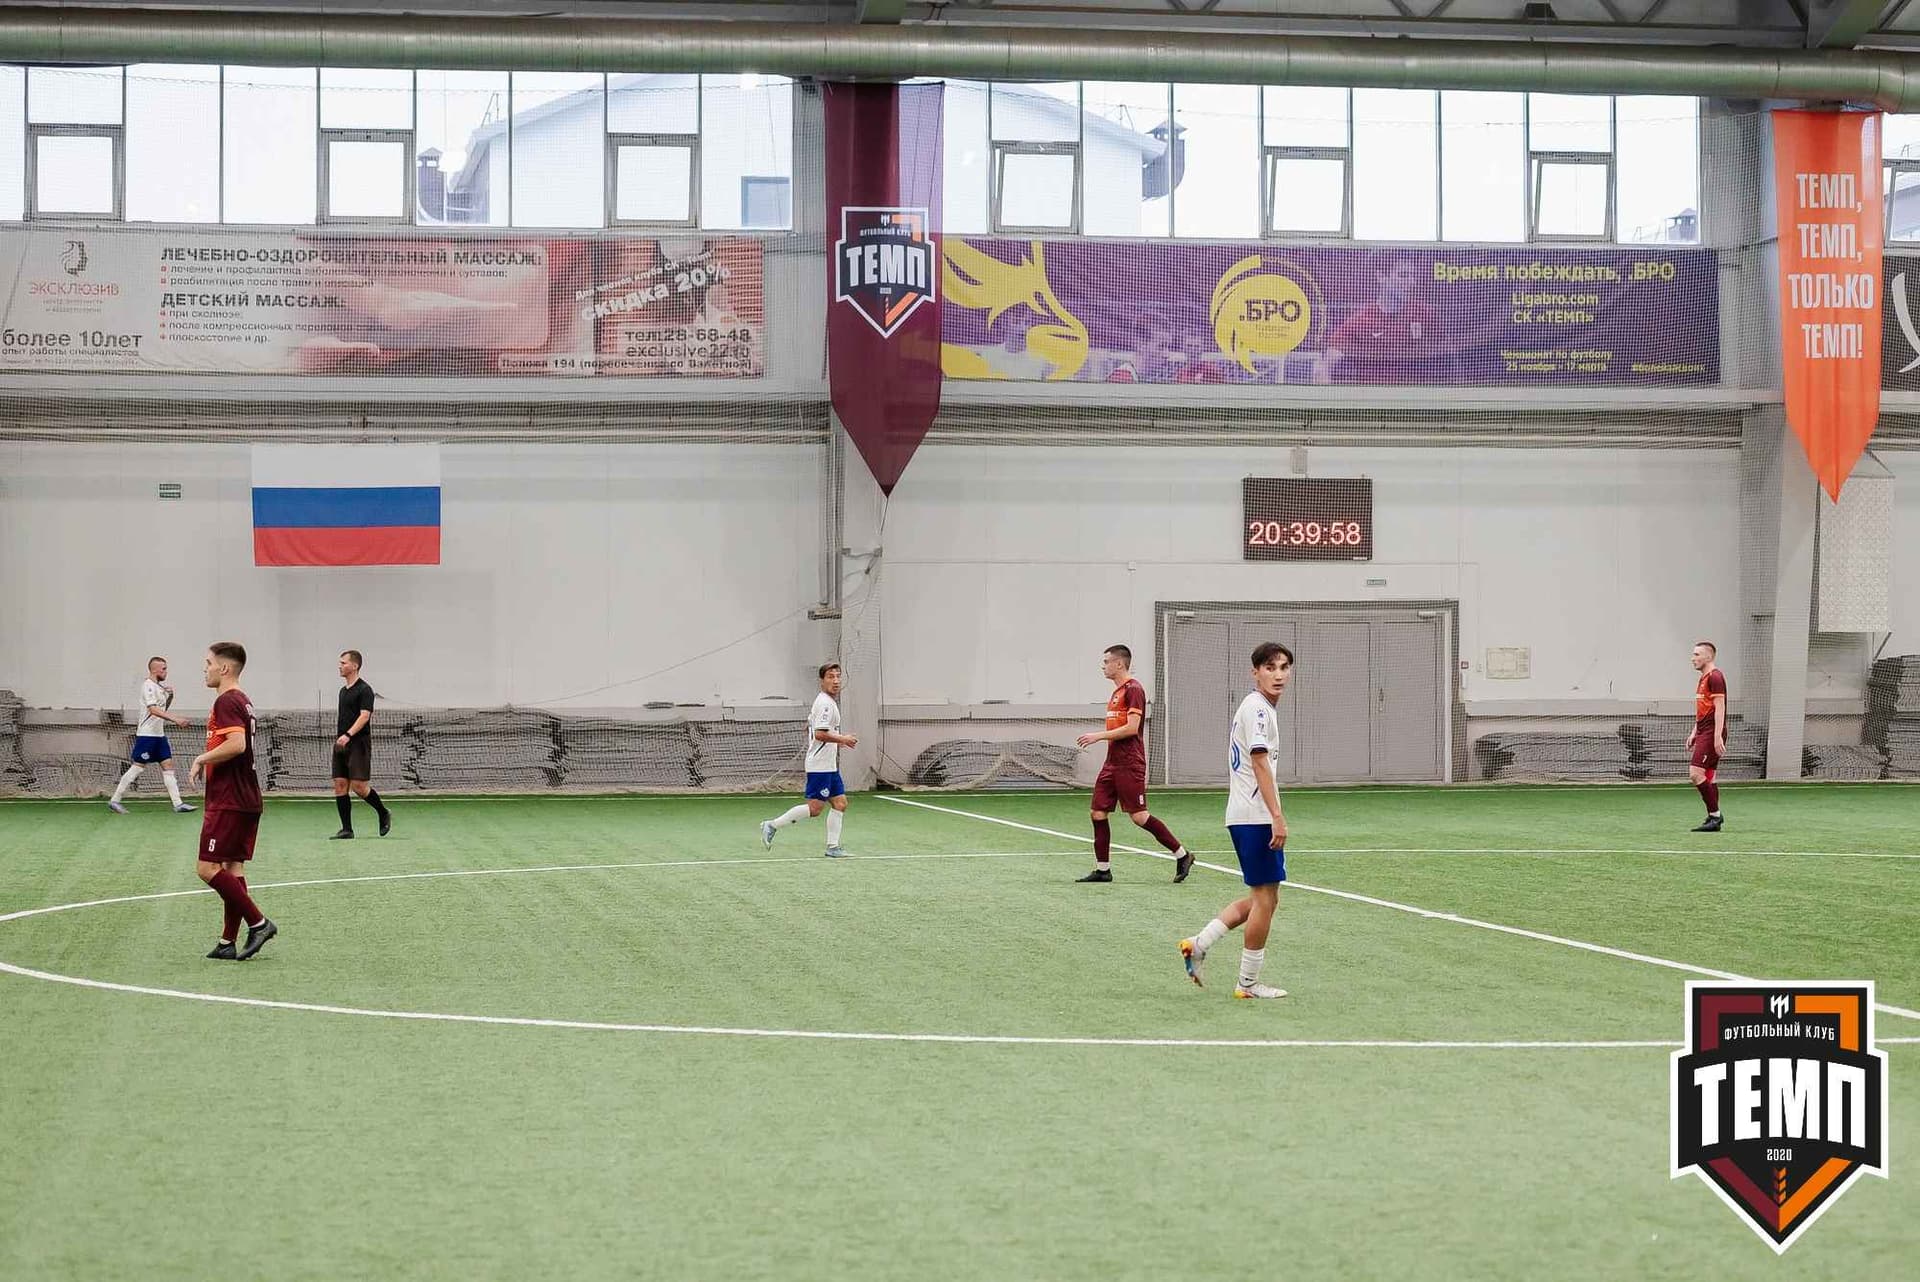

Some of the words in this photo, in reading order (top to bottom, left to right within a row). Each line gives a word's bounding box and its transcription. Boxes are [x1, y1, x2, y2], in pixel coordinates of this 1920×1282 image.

[1796, 173, 1863, 213] ТЕМП,
[1797, 223, 1863, 262] ТЕМП,
[161, 247, 447, 265] ЛЕЧЕБНО-ОЗДОРОВИТЕЛЬНЫЙ
[846, 244, 925, 288] ТЕМП
[674, 262, 732, 294] 20%
[1432, 262, 1498, 283] Время
[29, 282, 120, 296] ЭКСКЛЮЗИВ
[161, 291, 249, 308] ДЕТСКИЙ
[1788, 273, 1874, 309] ТОЛЬКО
[2, 328, 71, 347] более
[79, 330, 143, 349] 10лет
[1801, 323, 1863, 359] ТЕМП!
[553, 358, 575, 369] 194
[1249, 521, 1361, 545] 20:39:58
